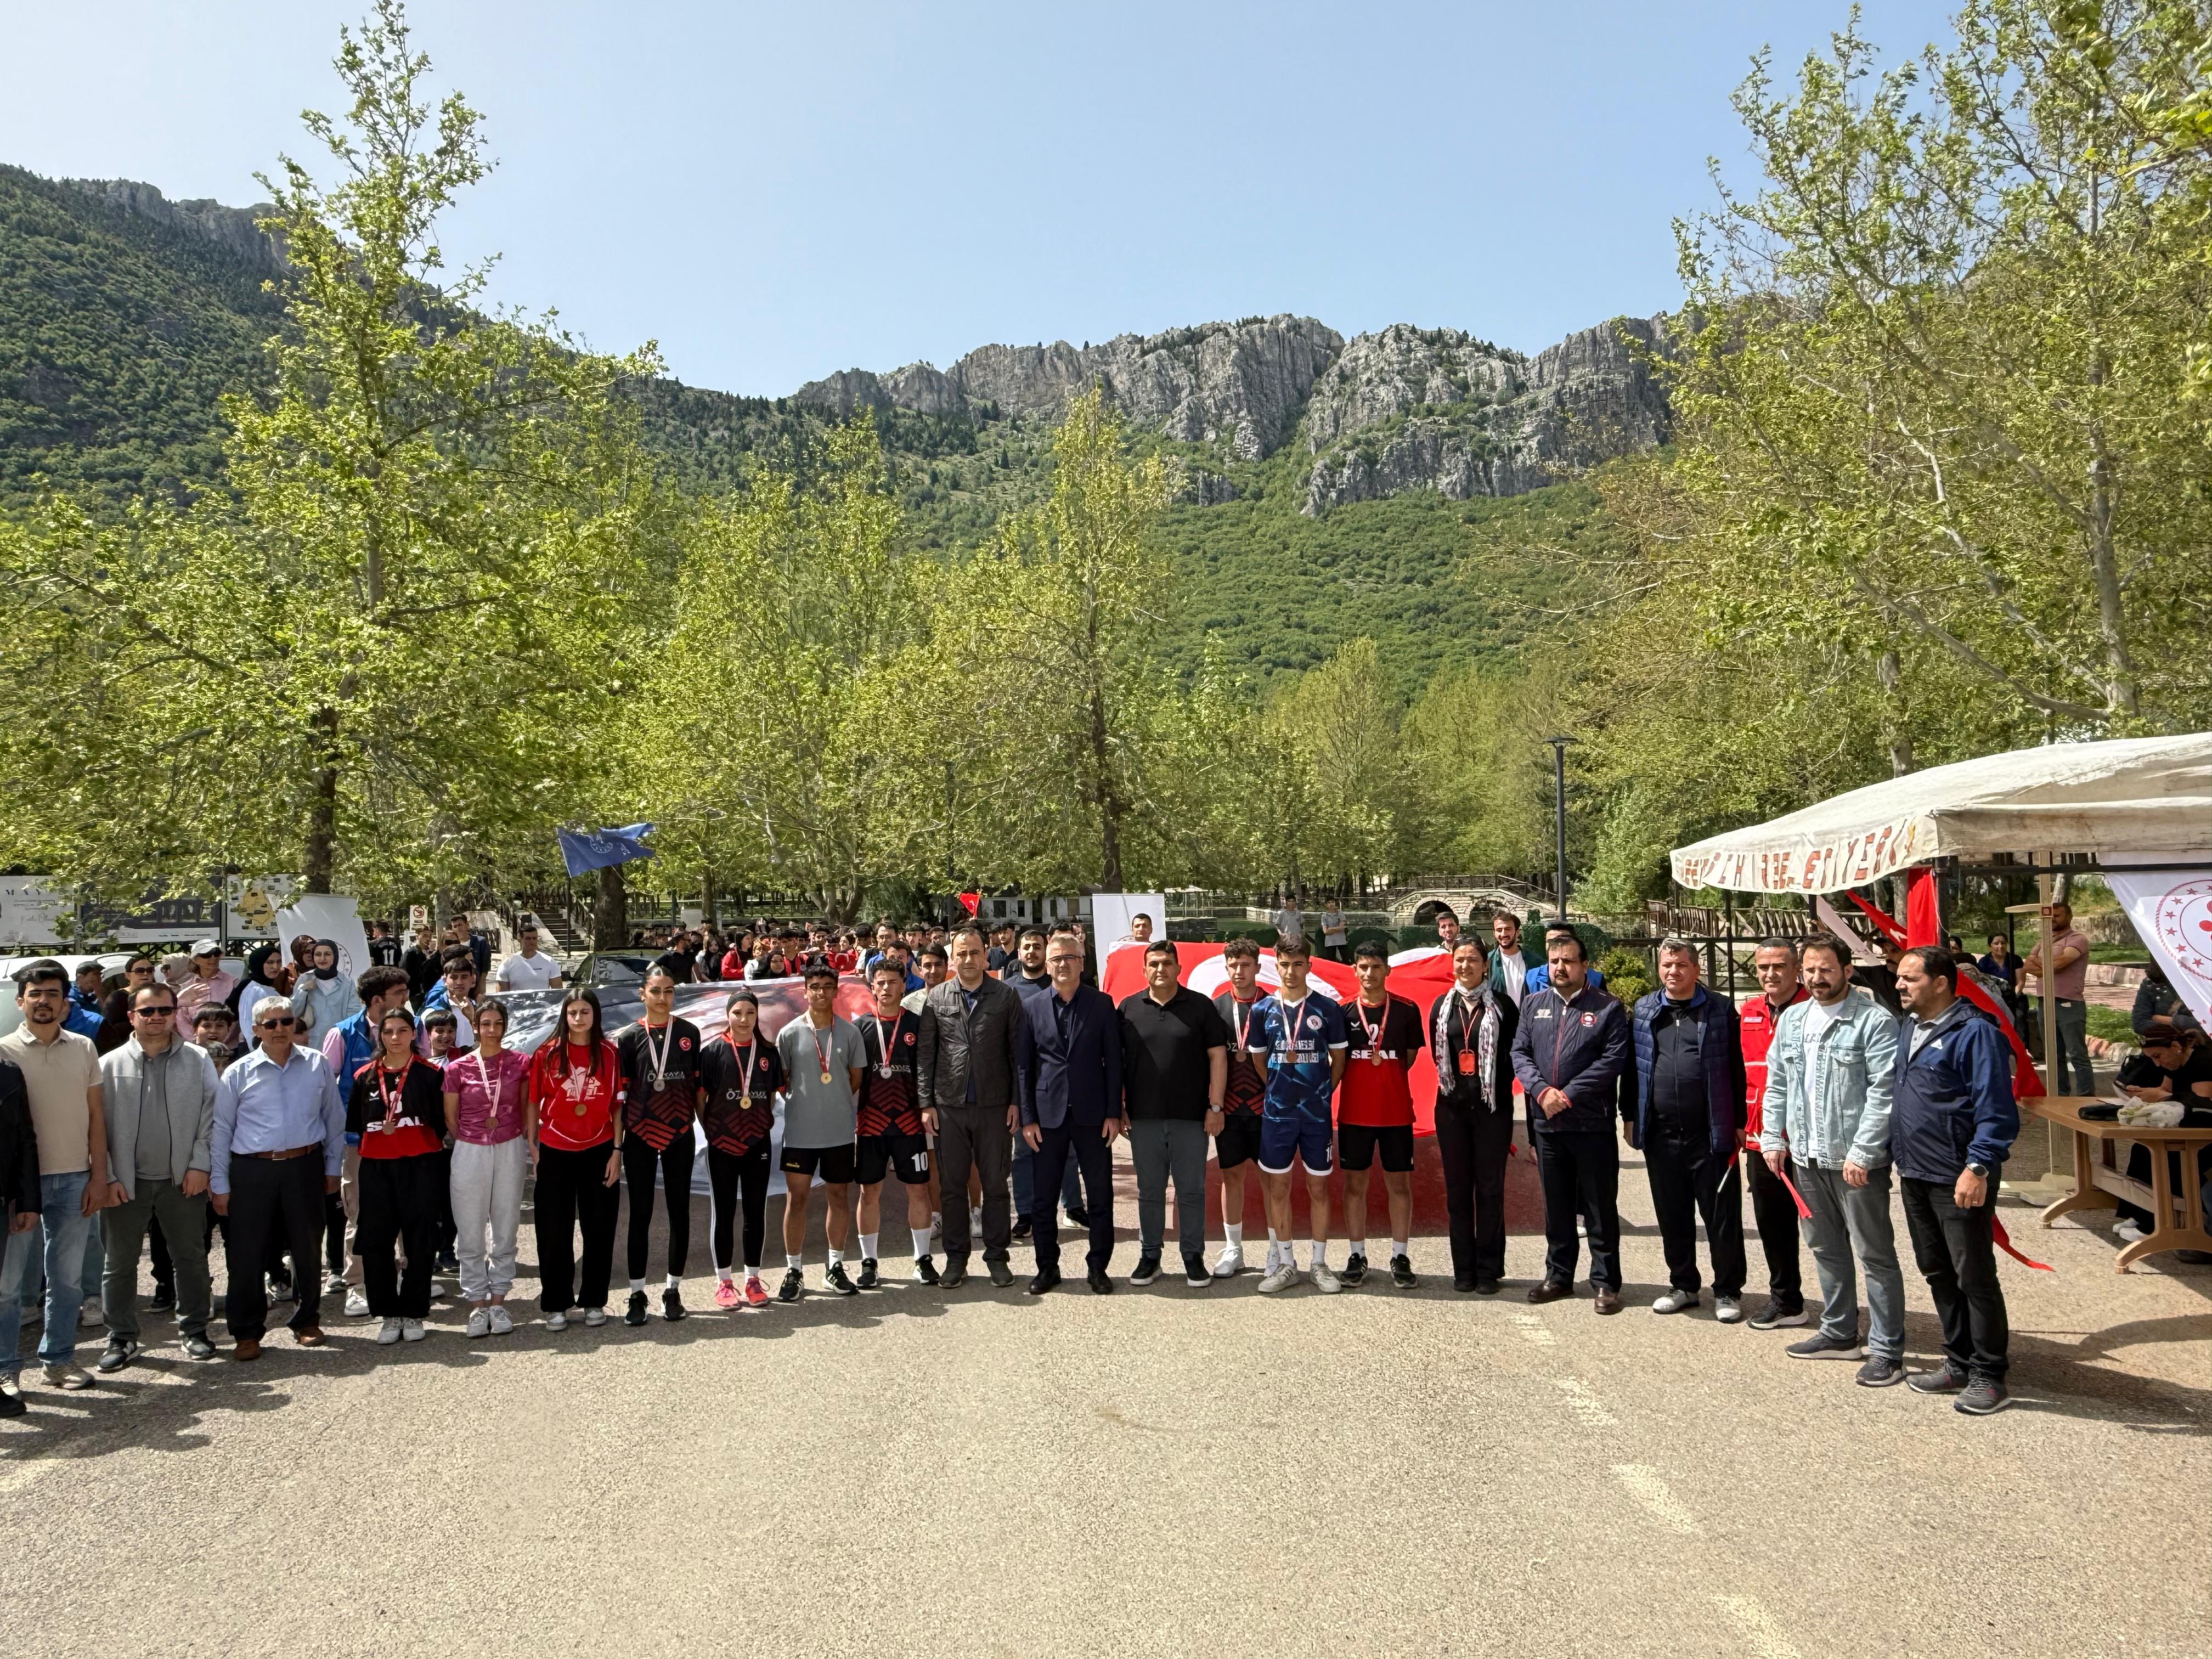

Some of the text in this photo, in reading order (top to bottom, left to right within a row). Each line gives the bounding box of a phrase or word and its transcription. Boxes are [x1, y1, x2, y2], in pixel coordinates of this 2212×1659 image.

[383, 949, 394, 966] 11
[1368, 1024, 1379, 1045] 2
[366, 1116, 424, 1132] SAL
[911, 1152, 928, 1172] 10
